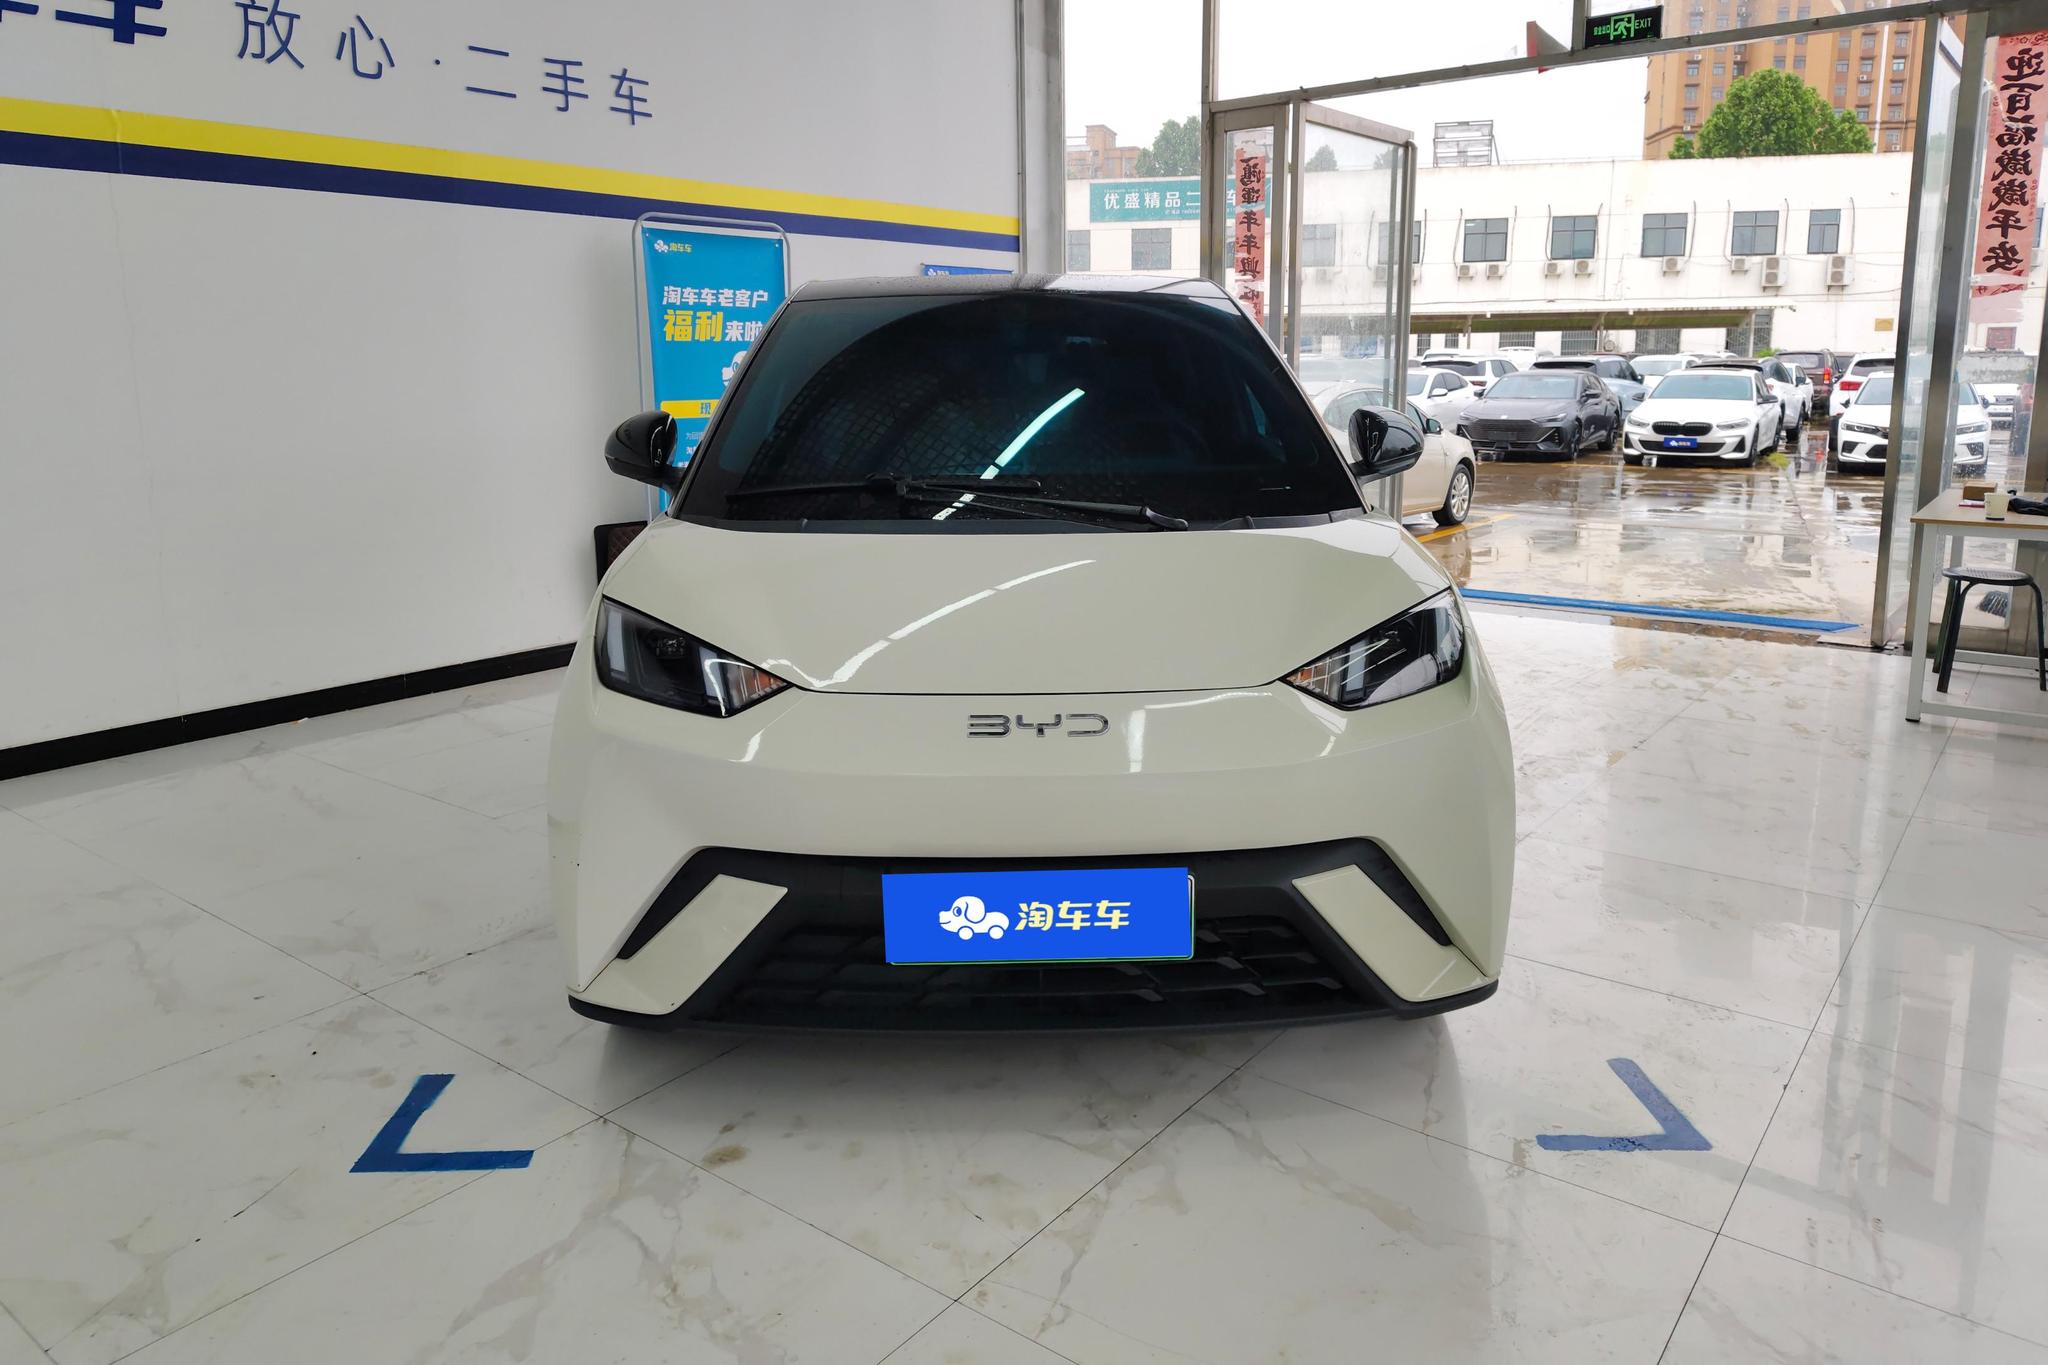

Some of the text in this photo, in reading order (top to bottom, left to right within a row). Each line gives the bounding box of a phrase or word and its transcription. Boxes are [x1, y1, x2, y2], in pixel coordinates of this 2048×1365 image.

[1635, 17, 1652, 30] EXIT
[662, 285, 769, 308] 淘车车老客户
[967, 713, 1109, 738] BYD
